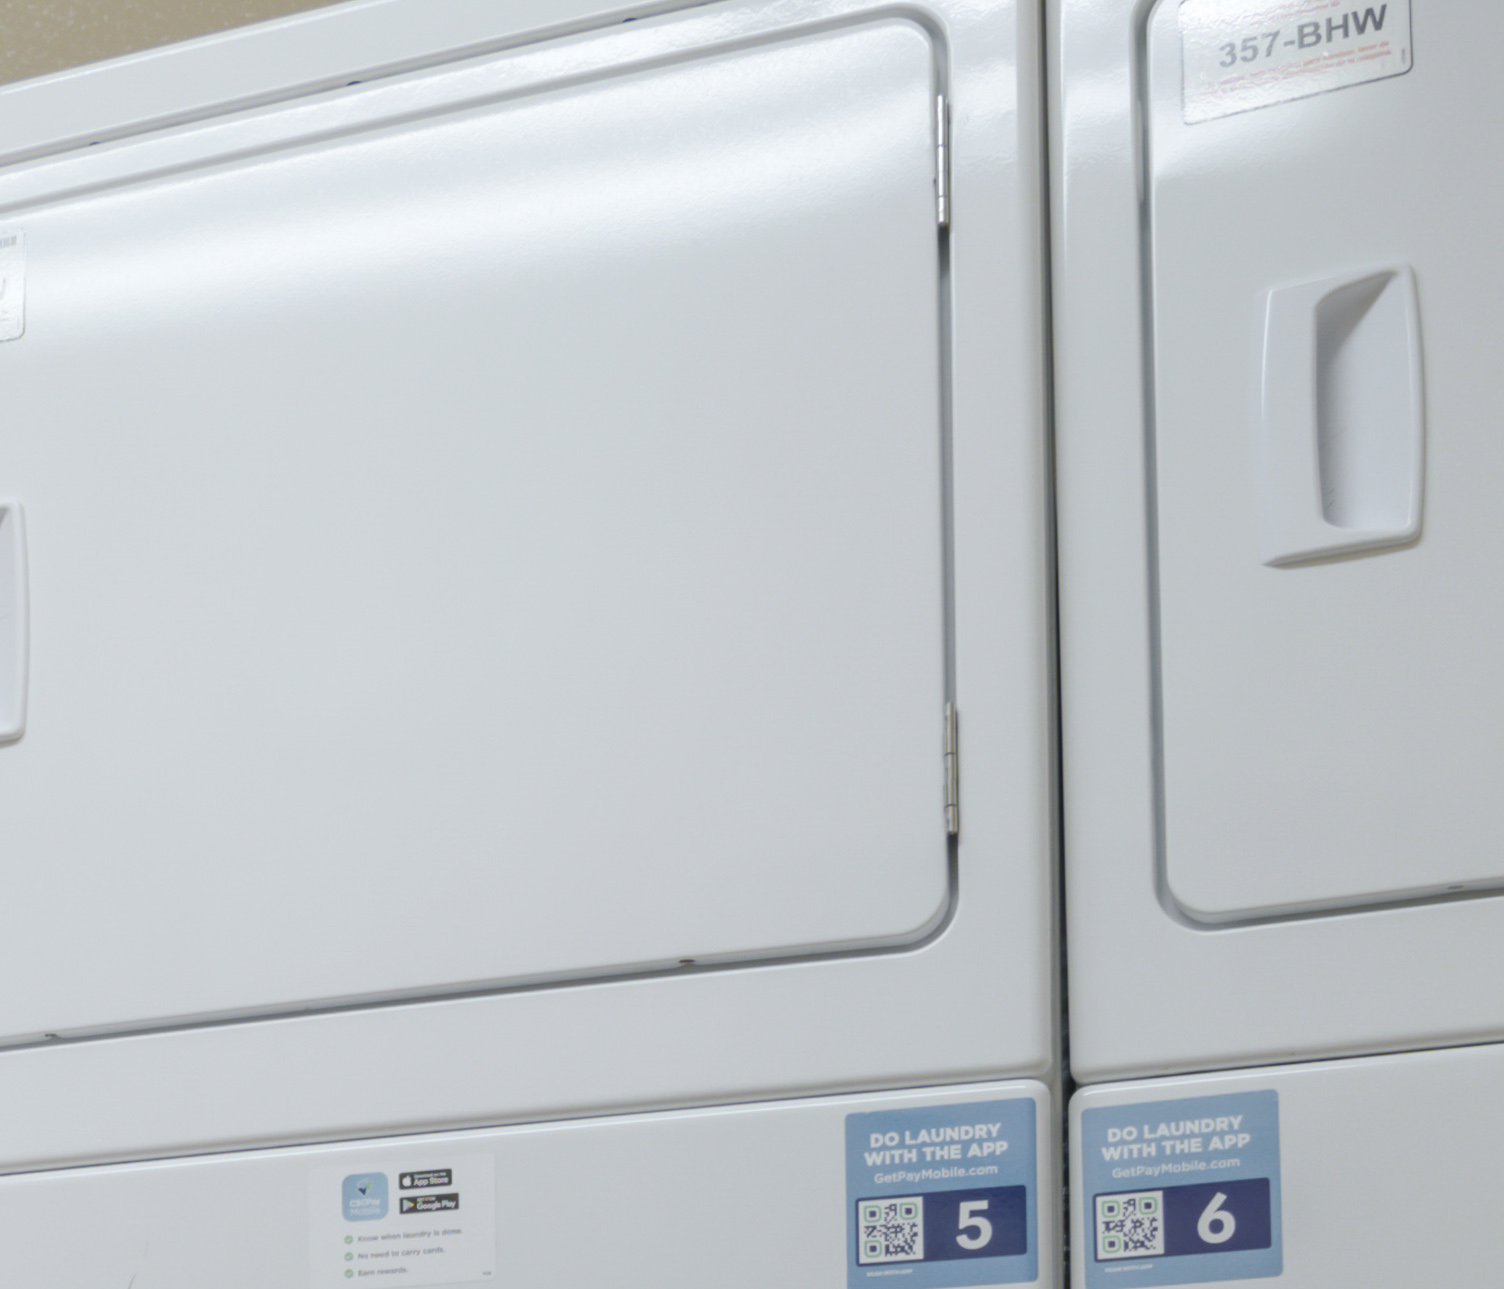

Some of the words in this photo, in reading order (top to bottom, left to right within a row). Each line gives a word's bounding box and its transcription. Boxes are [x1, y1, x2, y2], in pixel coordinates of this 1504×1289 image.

[1219, 4, 1387, 68] 357-BHW
[870, 1132, 899, 1148] DO
[905, 1123, 1002, 1145] LAUNDRY
[1107, 1127, 1137, 1142] DO
[1144, 1115, 1243, 1139] LAUNDRY
[864, 1148, 916, 1166] WITH
[922, 1144, 962, 1161] THE
[967, 1141, 1008, 1158] APP
[1101, 1143, 1156, 1161] WITH
[1162, 1138, 1202, 1155] THE
[1208, 1133, 1251, 1151] APP
[874, 1165, 998, 1183] GetPayMobile.com
[1112, 1158, 1240, 1178] GetPayMobile.com
[956, 1200, 993, 1250] 5
[1197, 1191, 1236, 1244] 6
